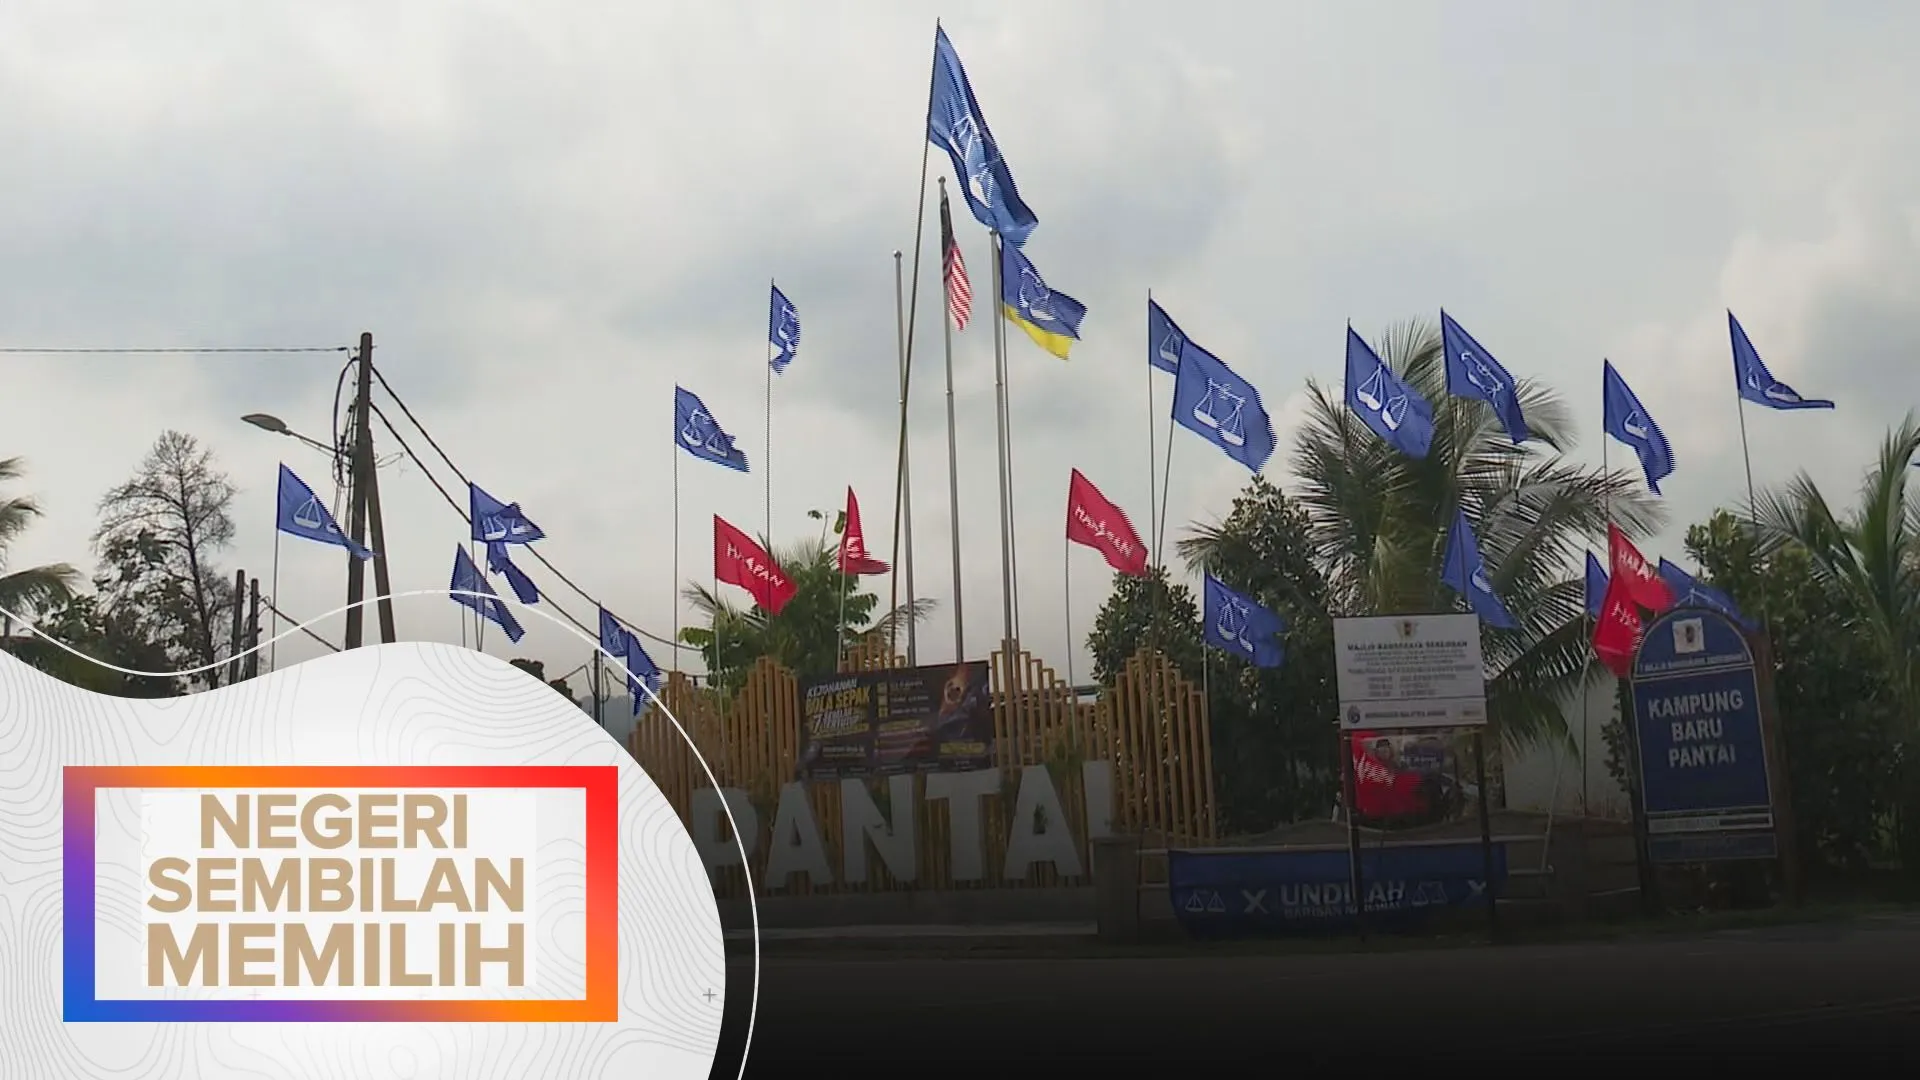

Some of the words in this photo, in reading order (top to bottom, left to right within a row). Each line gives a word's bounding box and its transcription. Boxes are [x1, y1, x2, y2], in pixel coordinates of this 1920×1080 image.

[834, 684, 872, 710] SEPAK
[1648, 689, 1744, 720] KAMPUNG
[1671, 718, 1723, 743] BARU
[1668, 744, 1736, 769] PANTAI
[692, 760, 1114, 888] PANTAI
[1280, 880, 1406, 906] UNDIAH
